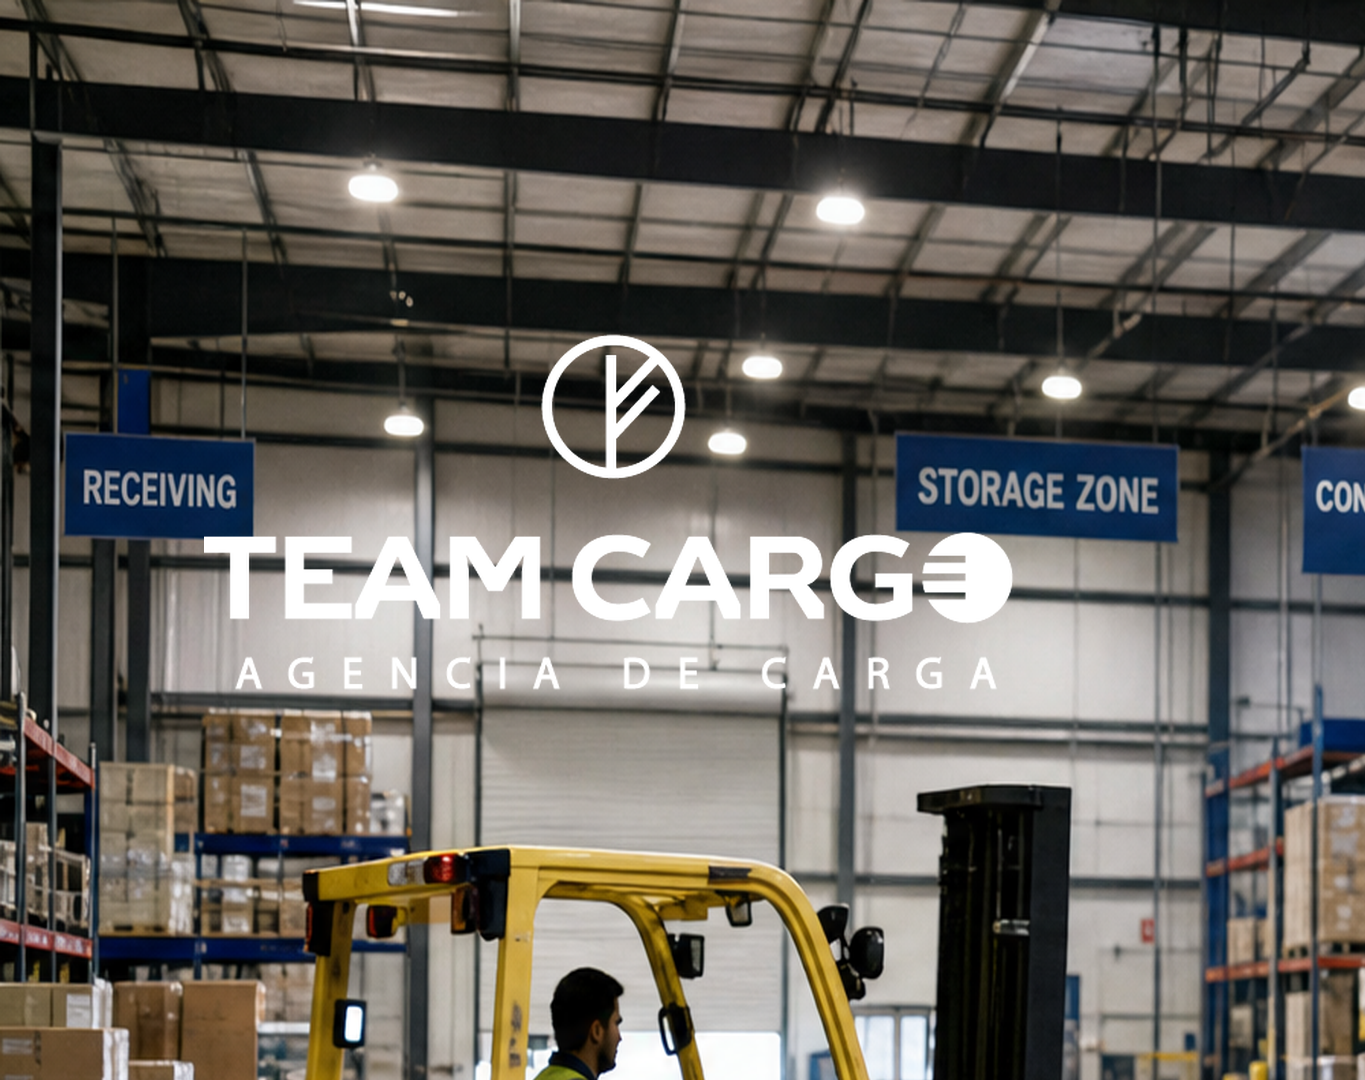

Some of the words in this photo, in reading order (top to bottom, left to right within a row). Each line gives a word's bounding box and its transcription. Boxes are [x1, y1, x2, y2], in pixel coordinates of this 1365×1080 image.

[83, 469, 237, 510] RECEIVING
[917, 466, 1065, 510] STORAGE
[1075, 474, 1159, 515] ZONE
